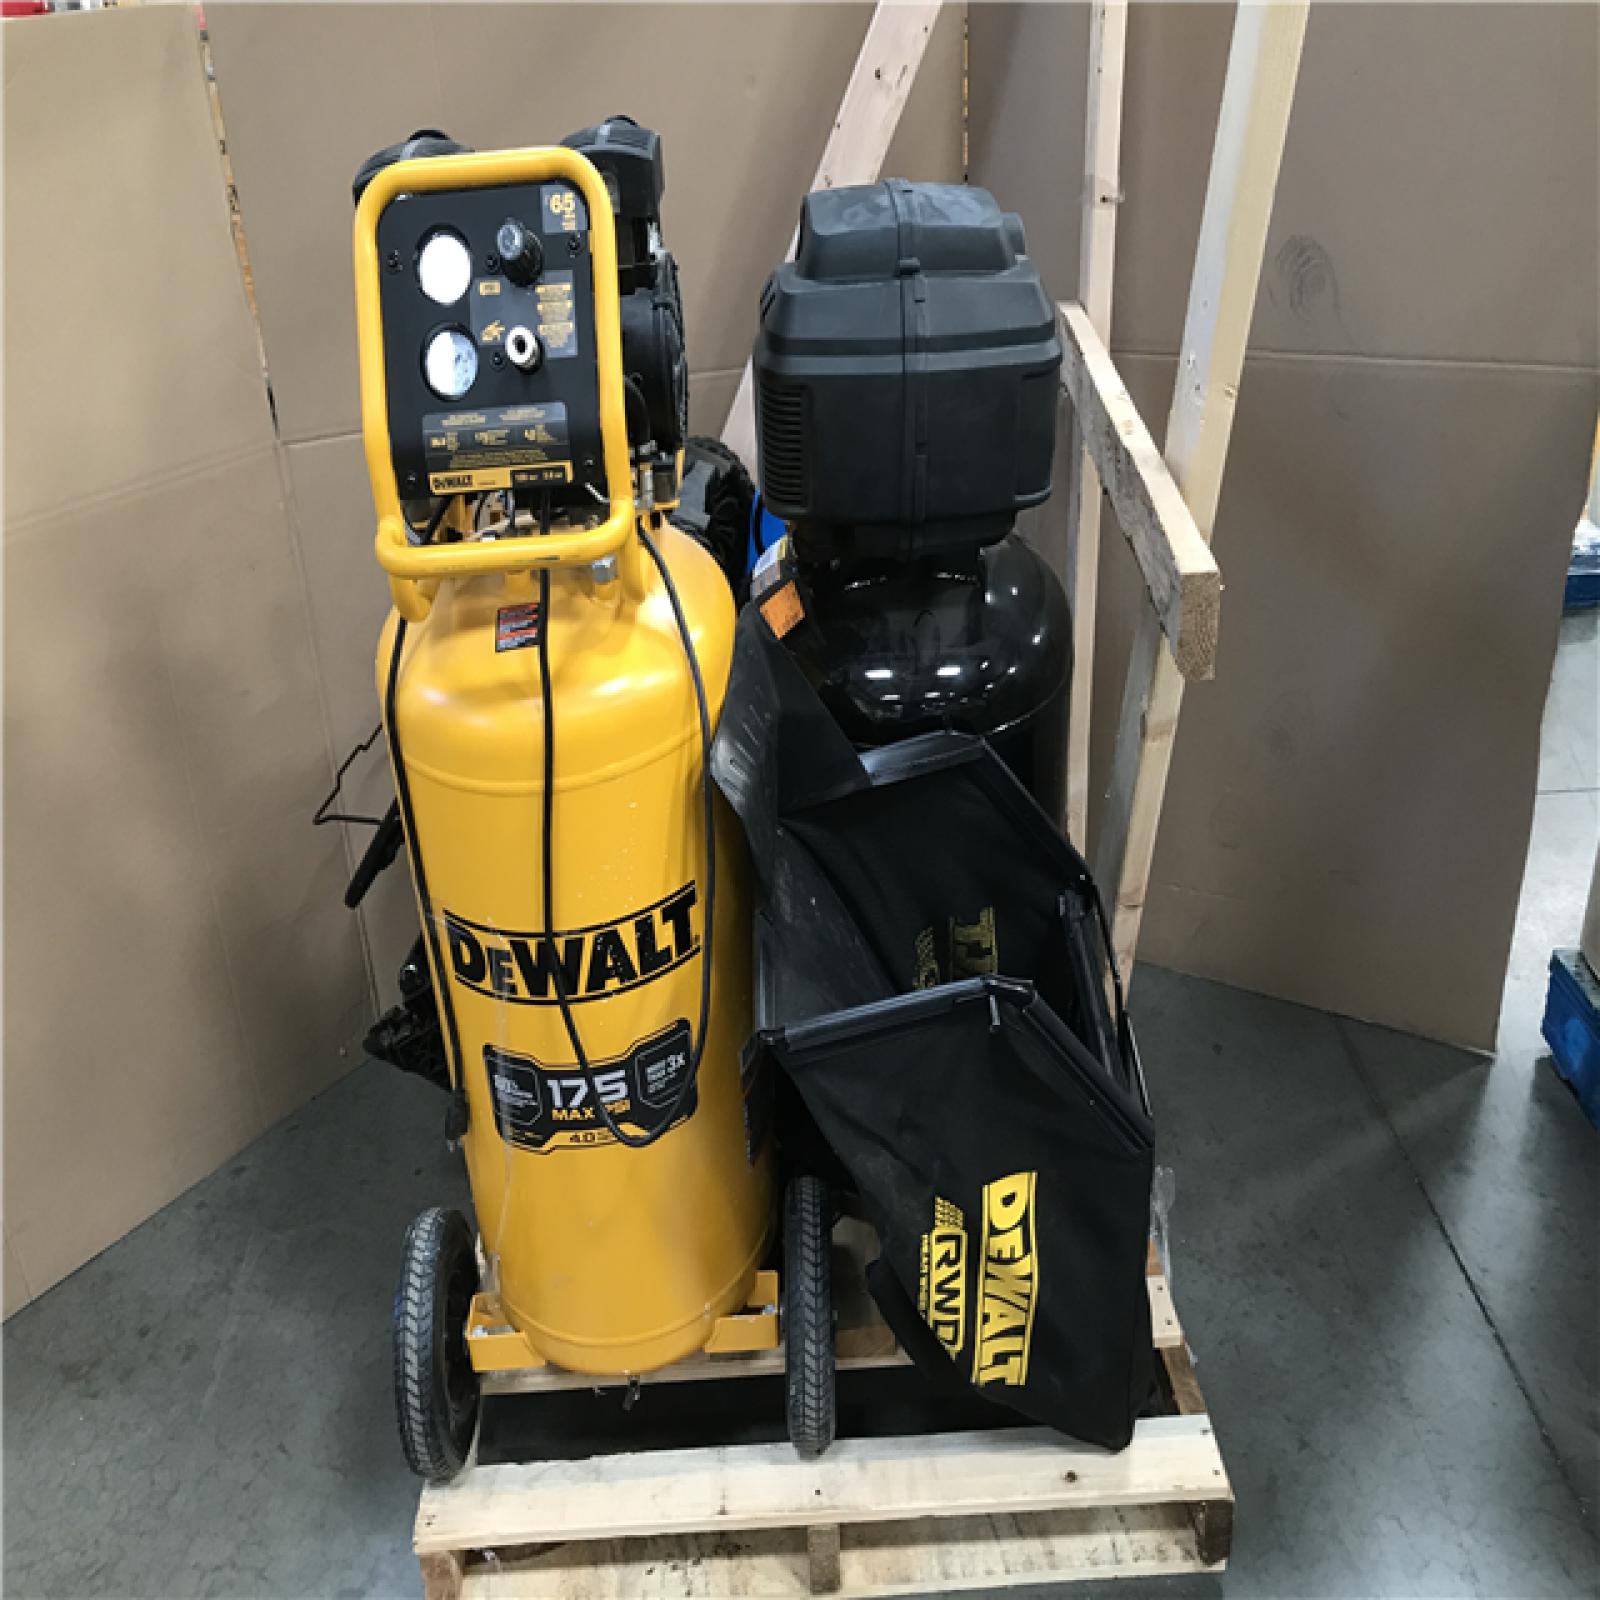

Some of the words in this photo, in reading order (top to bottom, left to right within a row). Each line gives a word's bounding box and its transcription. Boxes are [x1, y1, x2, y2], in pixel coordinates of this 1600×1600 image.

[550, 192, 575, 214] 65
[446, 886, 697, 996] DEWALT
[546, 1070, 628, 1108] 175
[551, 1106, 596, 1121] MAX
[932, 1233, 962, 1347] RWD
[977, 1171, 1034, 1387] DEWALT
